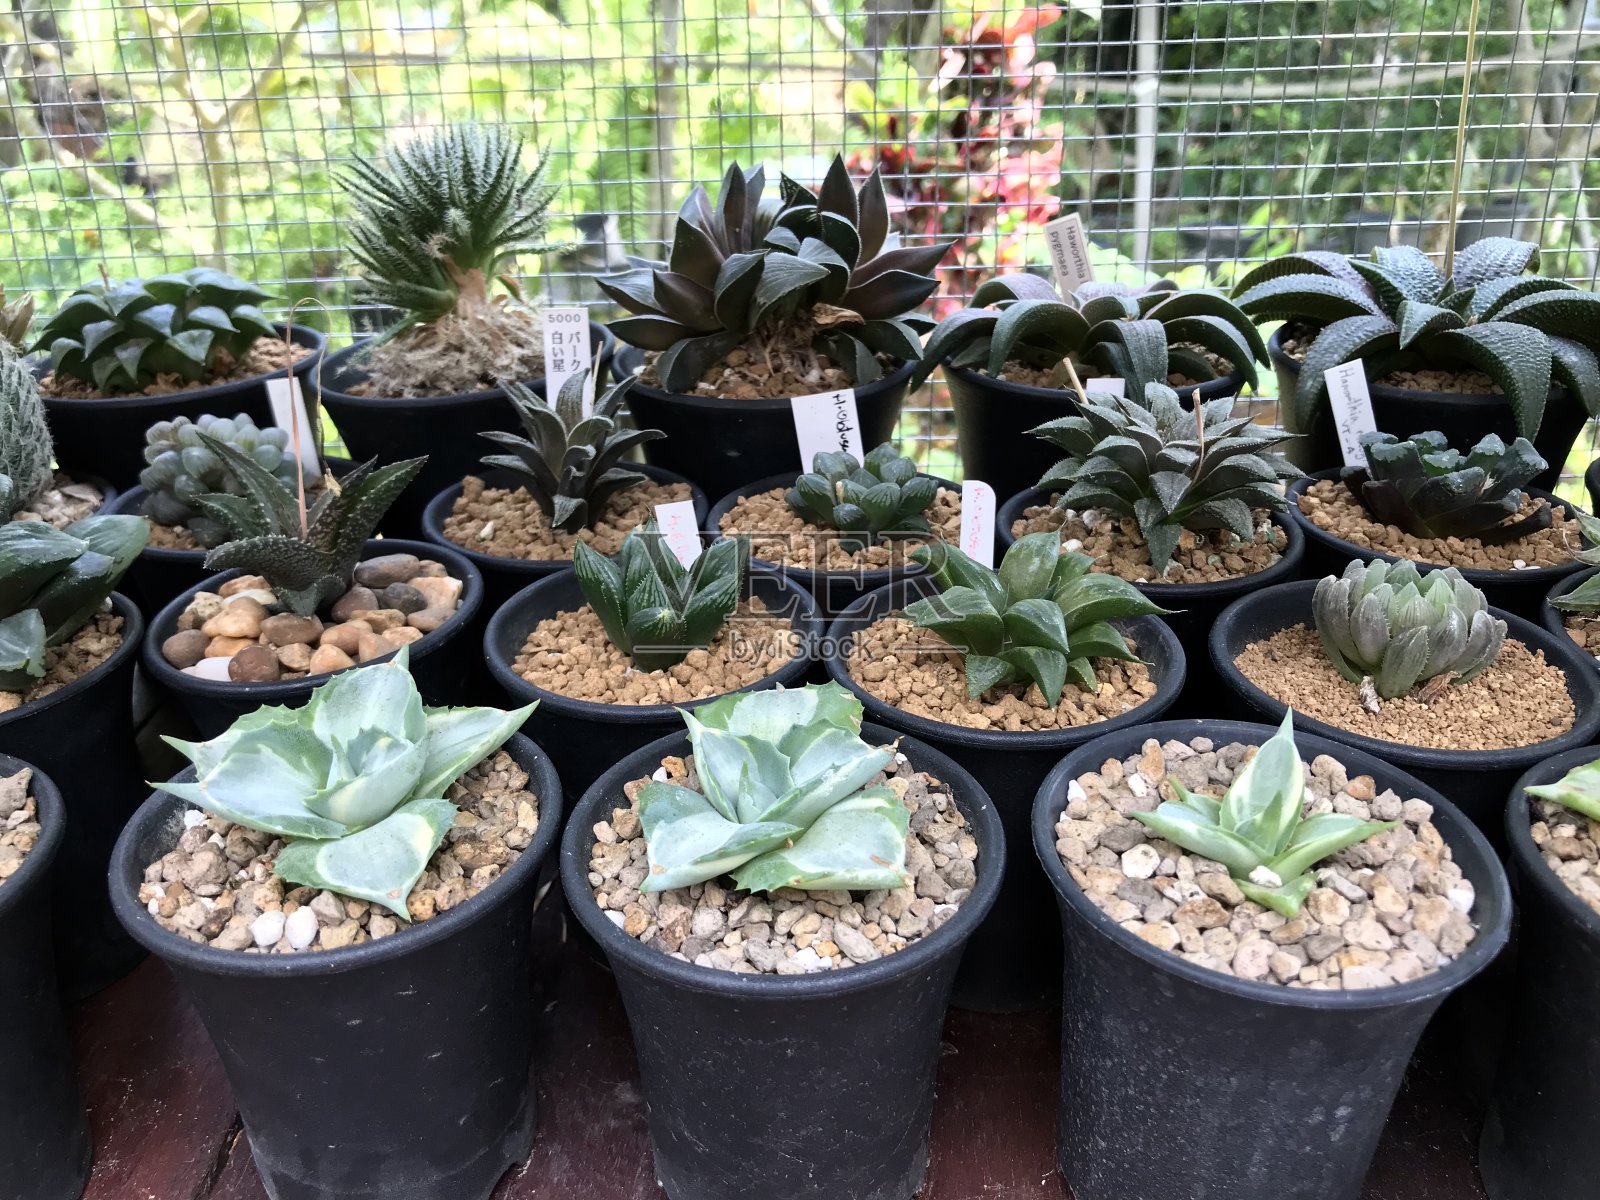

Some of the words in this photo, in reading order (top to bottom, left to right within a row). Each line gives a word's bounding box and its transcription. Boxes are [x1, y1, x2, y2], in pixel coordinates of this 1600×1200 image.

[1049, 231, 1069, 277] pygmaea
[1066, 226, 1086, 279] Haworthia
[548, 313, 581, 323] 5000
[551, 330, 566, 372] 白い星
[568, 331, 581, 372] パーク
